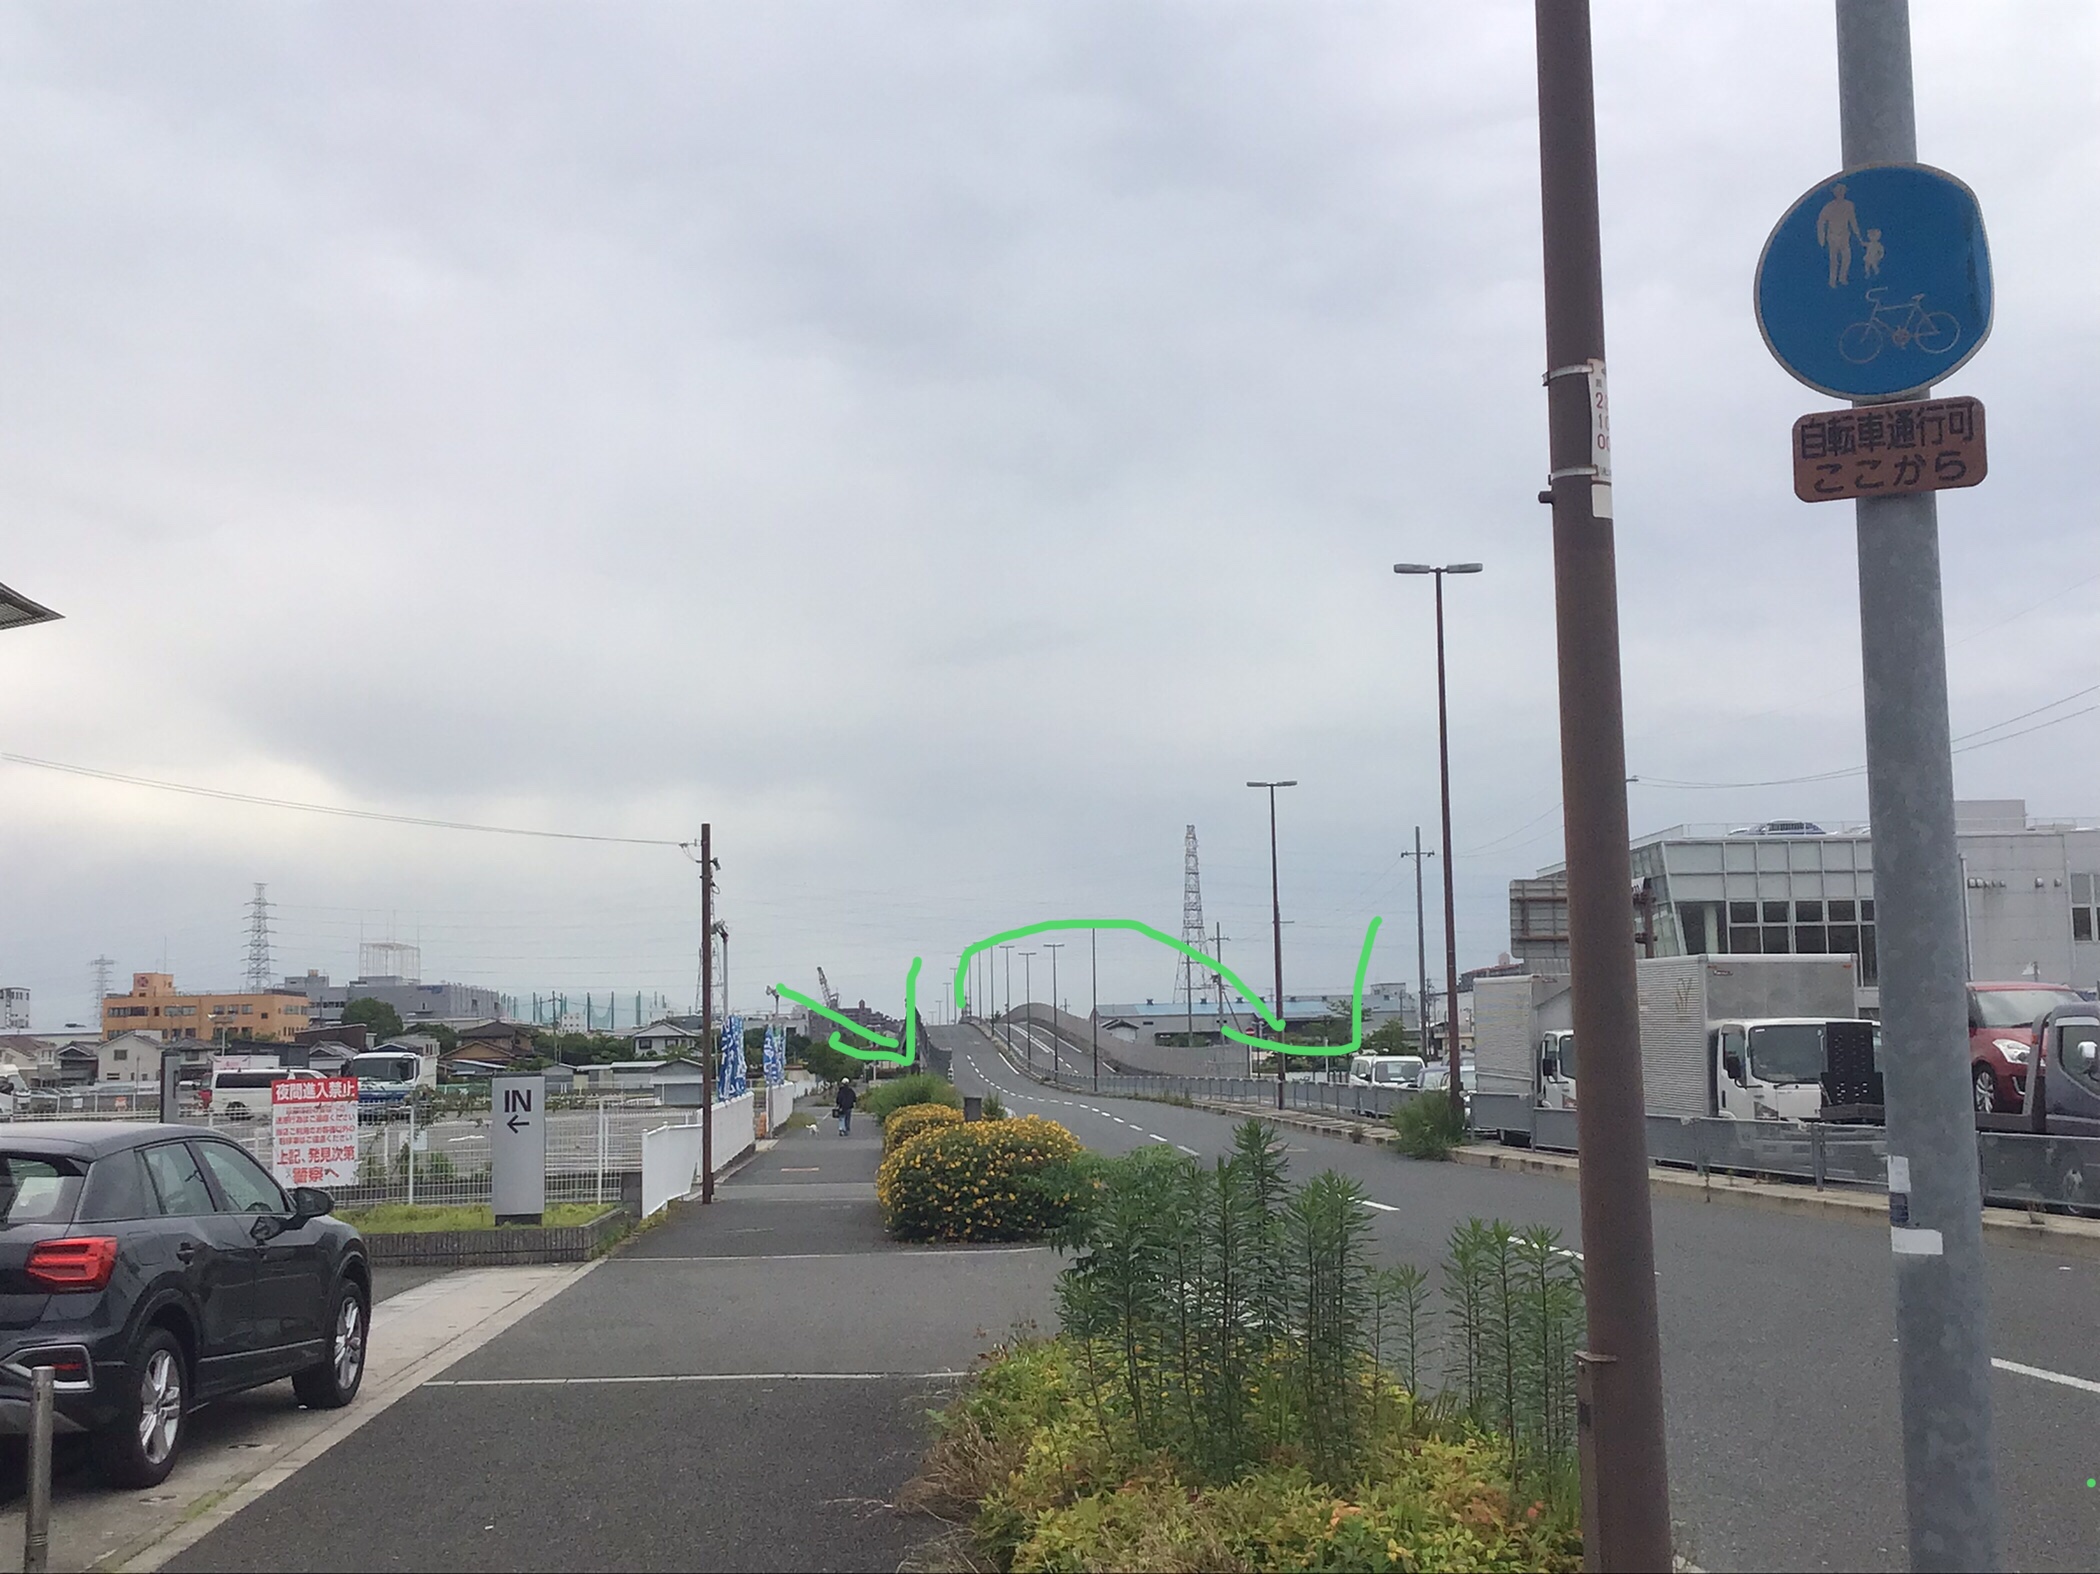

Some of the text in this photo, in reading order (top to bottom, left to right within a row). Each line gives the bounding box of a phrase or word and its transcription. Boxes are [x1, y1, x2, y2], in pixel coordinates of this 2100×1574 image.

[1801, 401, 1975, 460] 自転車通行可
[1814, 450, 1967, 494] ここから
[275, 1080, 355, 1101] 夜間進入禁止
[504, 1089, 532, 1113] IN
[276, 1145, 355, 1166] 上記、発見次第
[292, 1166, 340, 1185] 警察へ
